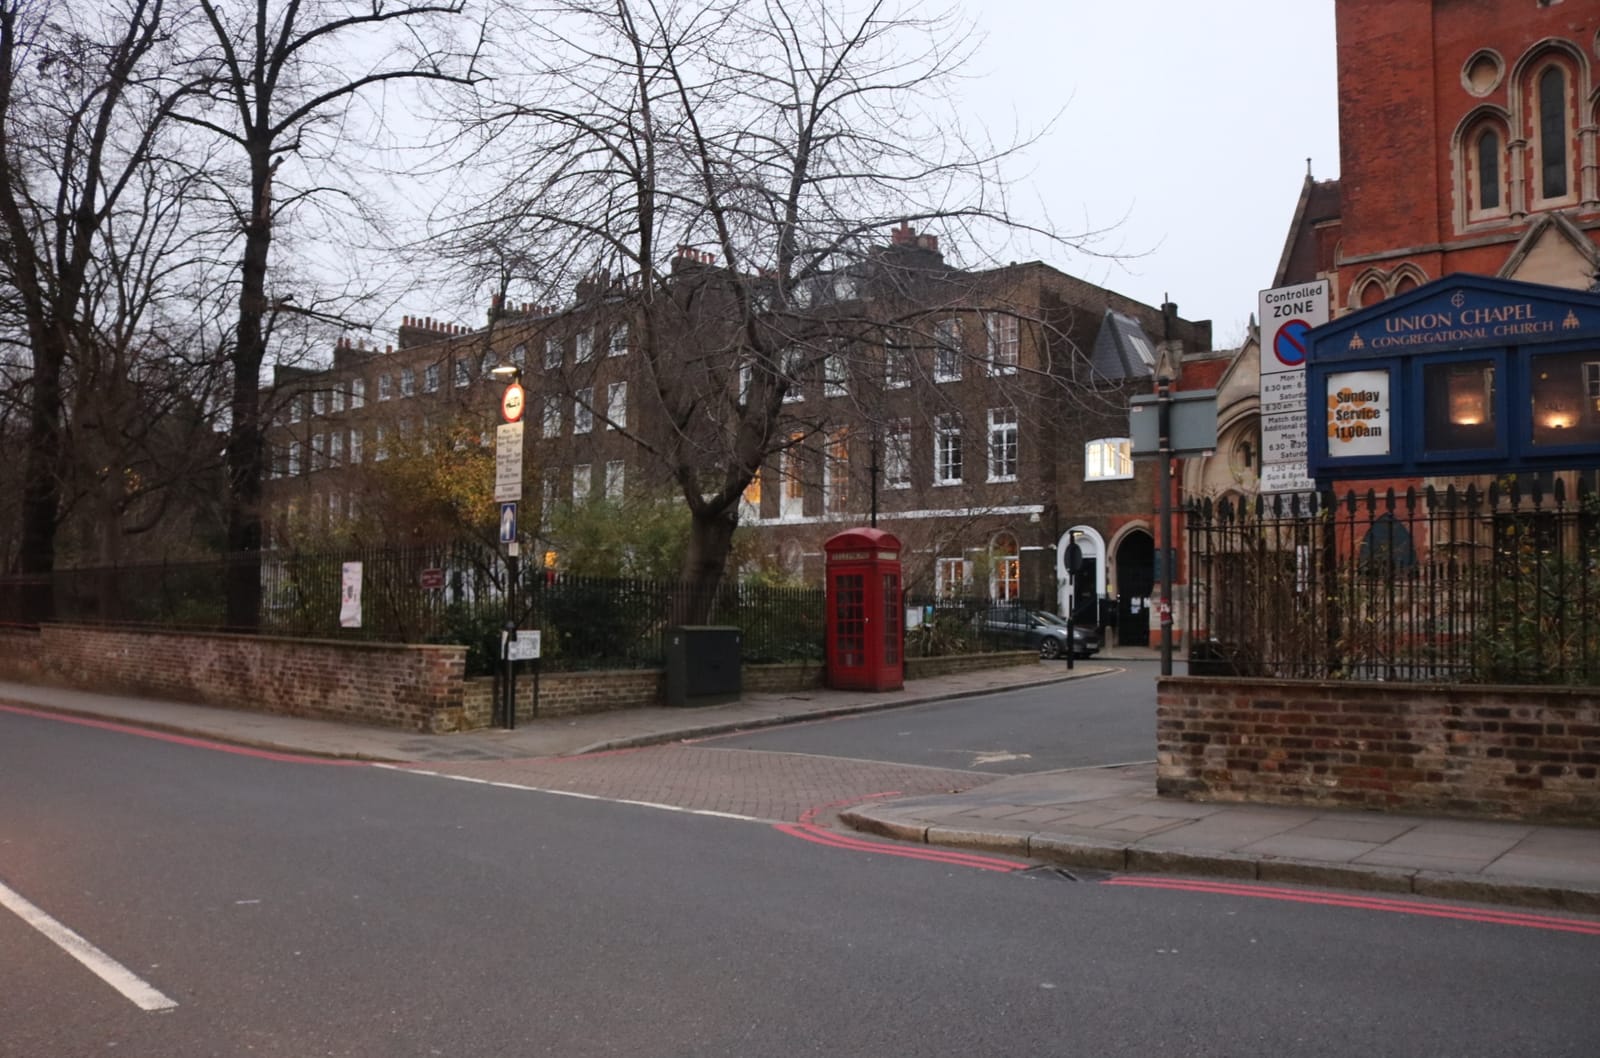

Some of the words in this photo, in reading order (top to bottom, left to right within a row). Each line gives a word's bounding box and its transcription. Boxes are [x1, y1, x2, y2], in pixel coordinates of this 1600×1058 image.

[1265, 285, 1323, 304] Controlled
[1273, 300, 1314, 318] ZONE
[1385, 312, 1452, 334] UNION
[1461, 303, 1536, 325] CHAPEL
[1371, 327, 1489, 349] CONGREGATIONAL
[1493, 320, 1554, 336] CHURCH
[1336, 390, 1380, 405] Sunday
[1336, 406, 1381, 421] Service
[1335, 424, 1382, 439] 11.00am
[1281, 451, 1307, 459] Saturda
